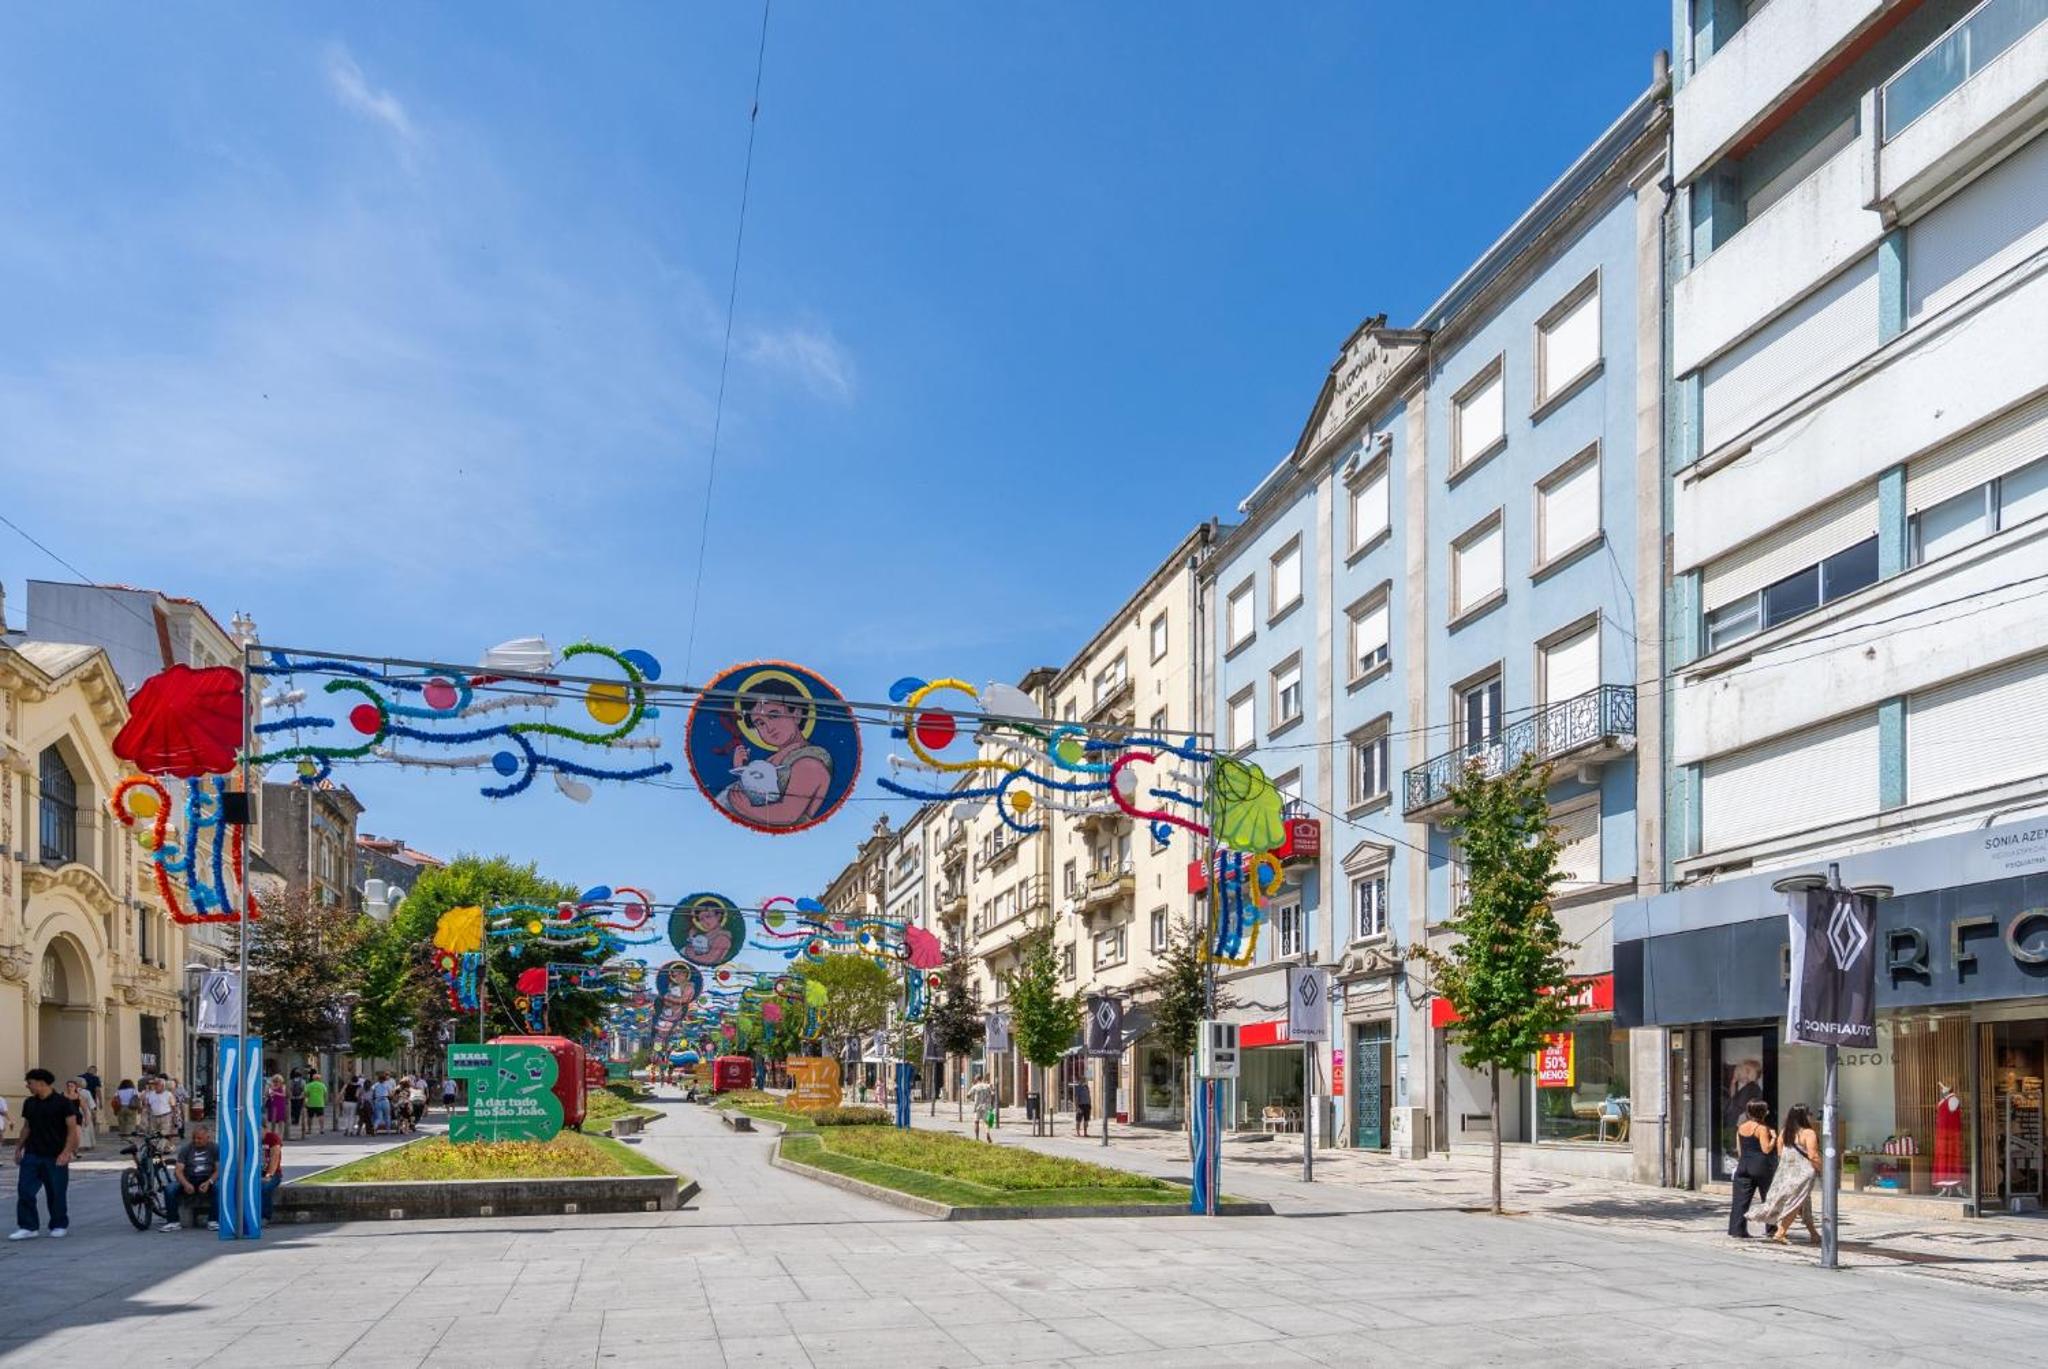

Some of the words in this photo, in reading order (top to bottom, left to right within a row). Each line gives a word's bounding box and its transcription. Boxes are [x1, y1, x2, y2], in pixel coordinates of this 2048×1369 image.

[1544, 1056, 1567, 1070] 50%
[1540, 1070, 1570, 1080] MENOS
[474, 1098, 484, 1107] A
[485, 1097, 508, 1107] dar
[508, 1097, 538, 1107] tudo
[474, 1108, 491, 1117] no
[491, 1106, 514, 1117] São
